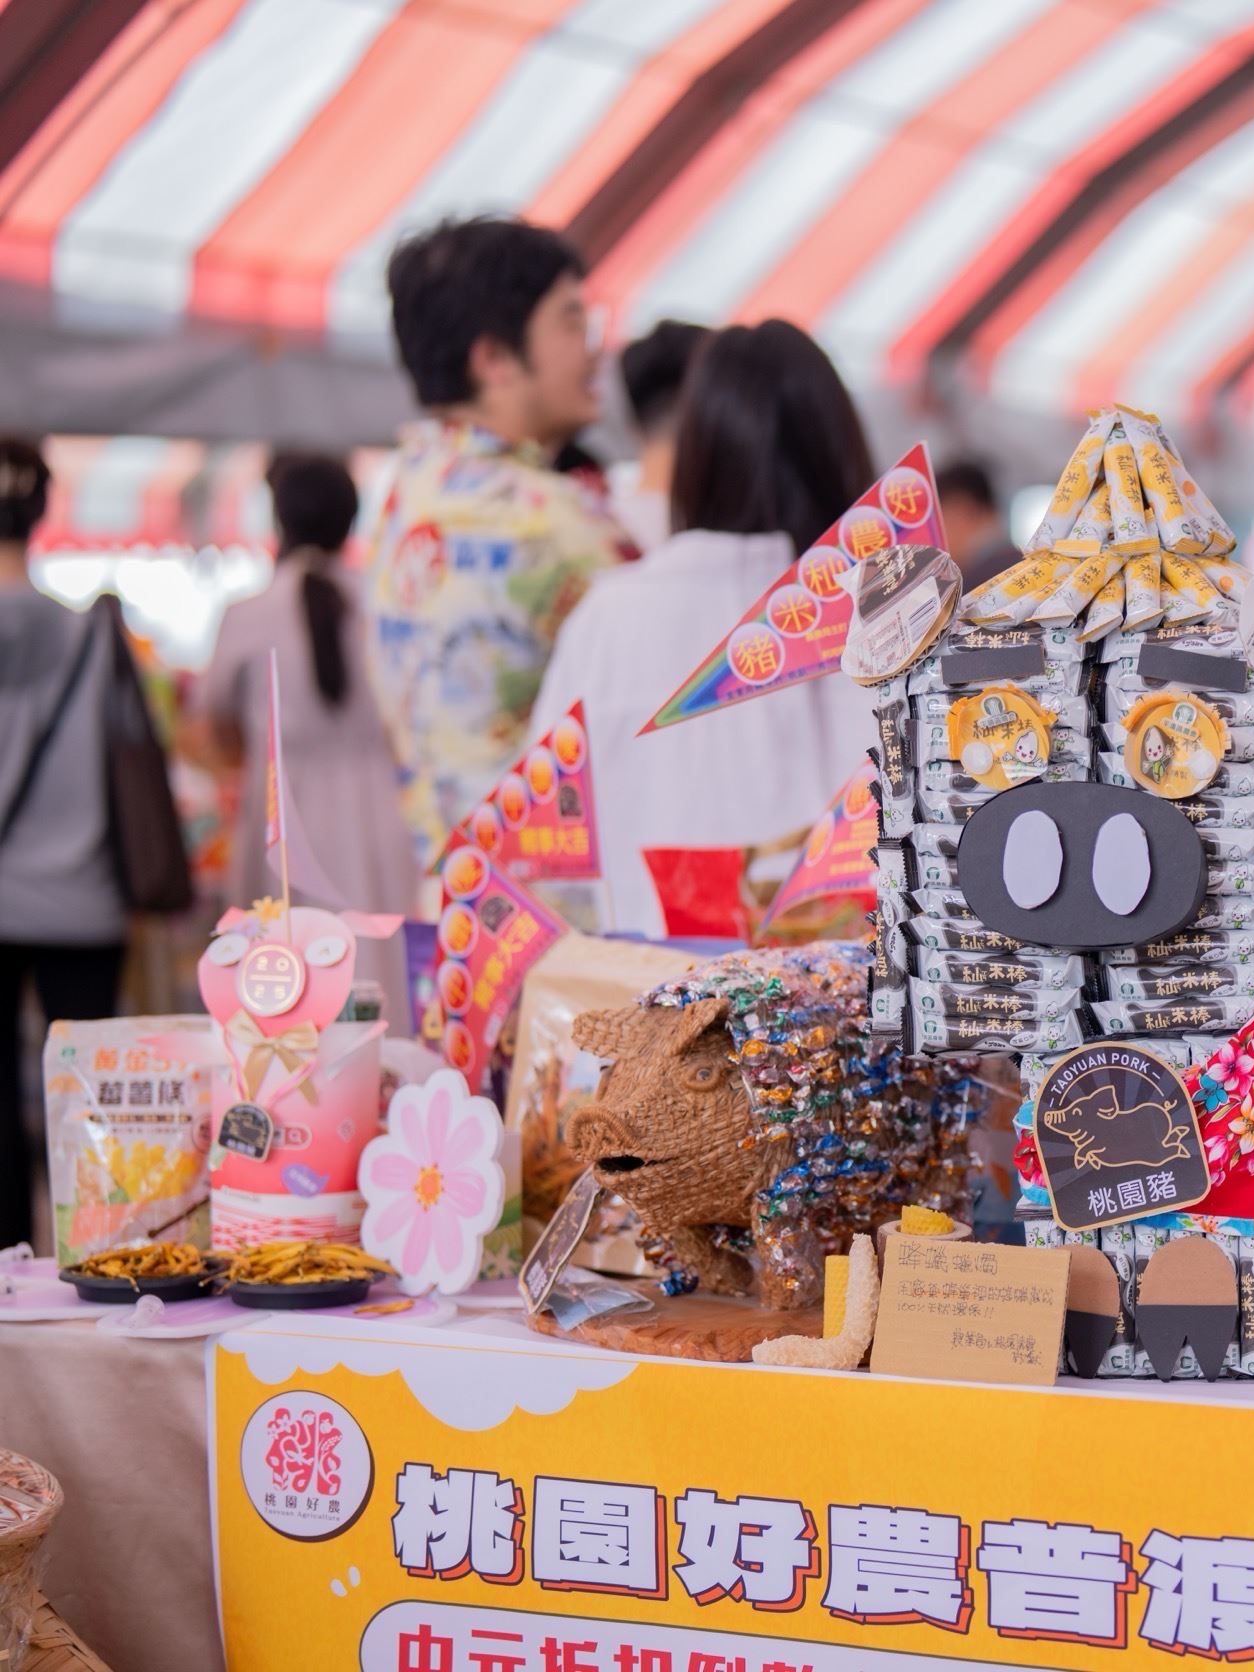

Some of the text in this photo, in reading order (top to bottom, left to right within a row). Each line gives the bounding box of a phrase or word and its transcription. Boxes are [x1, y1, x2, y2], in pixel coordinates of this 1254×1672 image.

[1147, 933, 1212, 958] 秈米棒
[255, 955, 289, 972] 20
[962, 963, 1028, 984] 秈米棒
[1156, 970, 1222, 997] 秈米棒
[956, 993, 1023, 1014] 秈米棒
[958, 1018, 1025, 1039] 秈米棒
[1145, 1006, 1212, 1031] 秈米棒
[1050, 1052, 1150, 1096] TAOYUAN PORK
[1087, 1170, 1178, 1218] 桃園豬
[264, 1492, 341, 1514] 桃園好農
